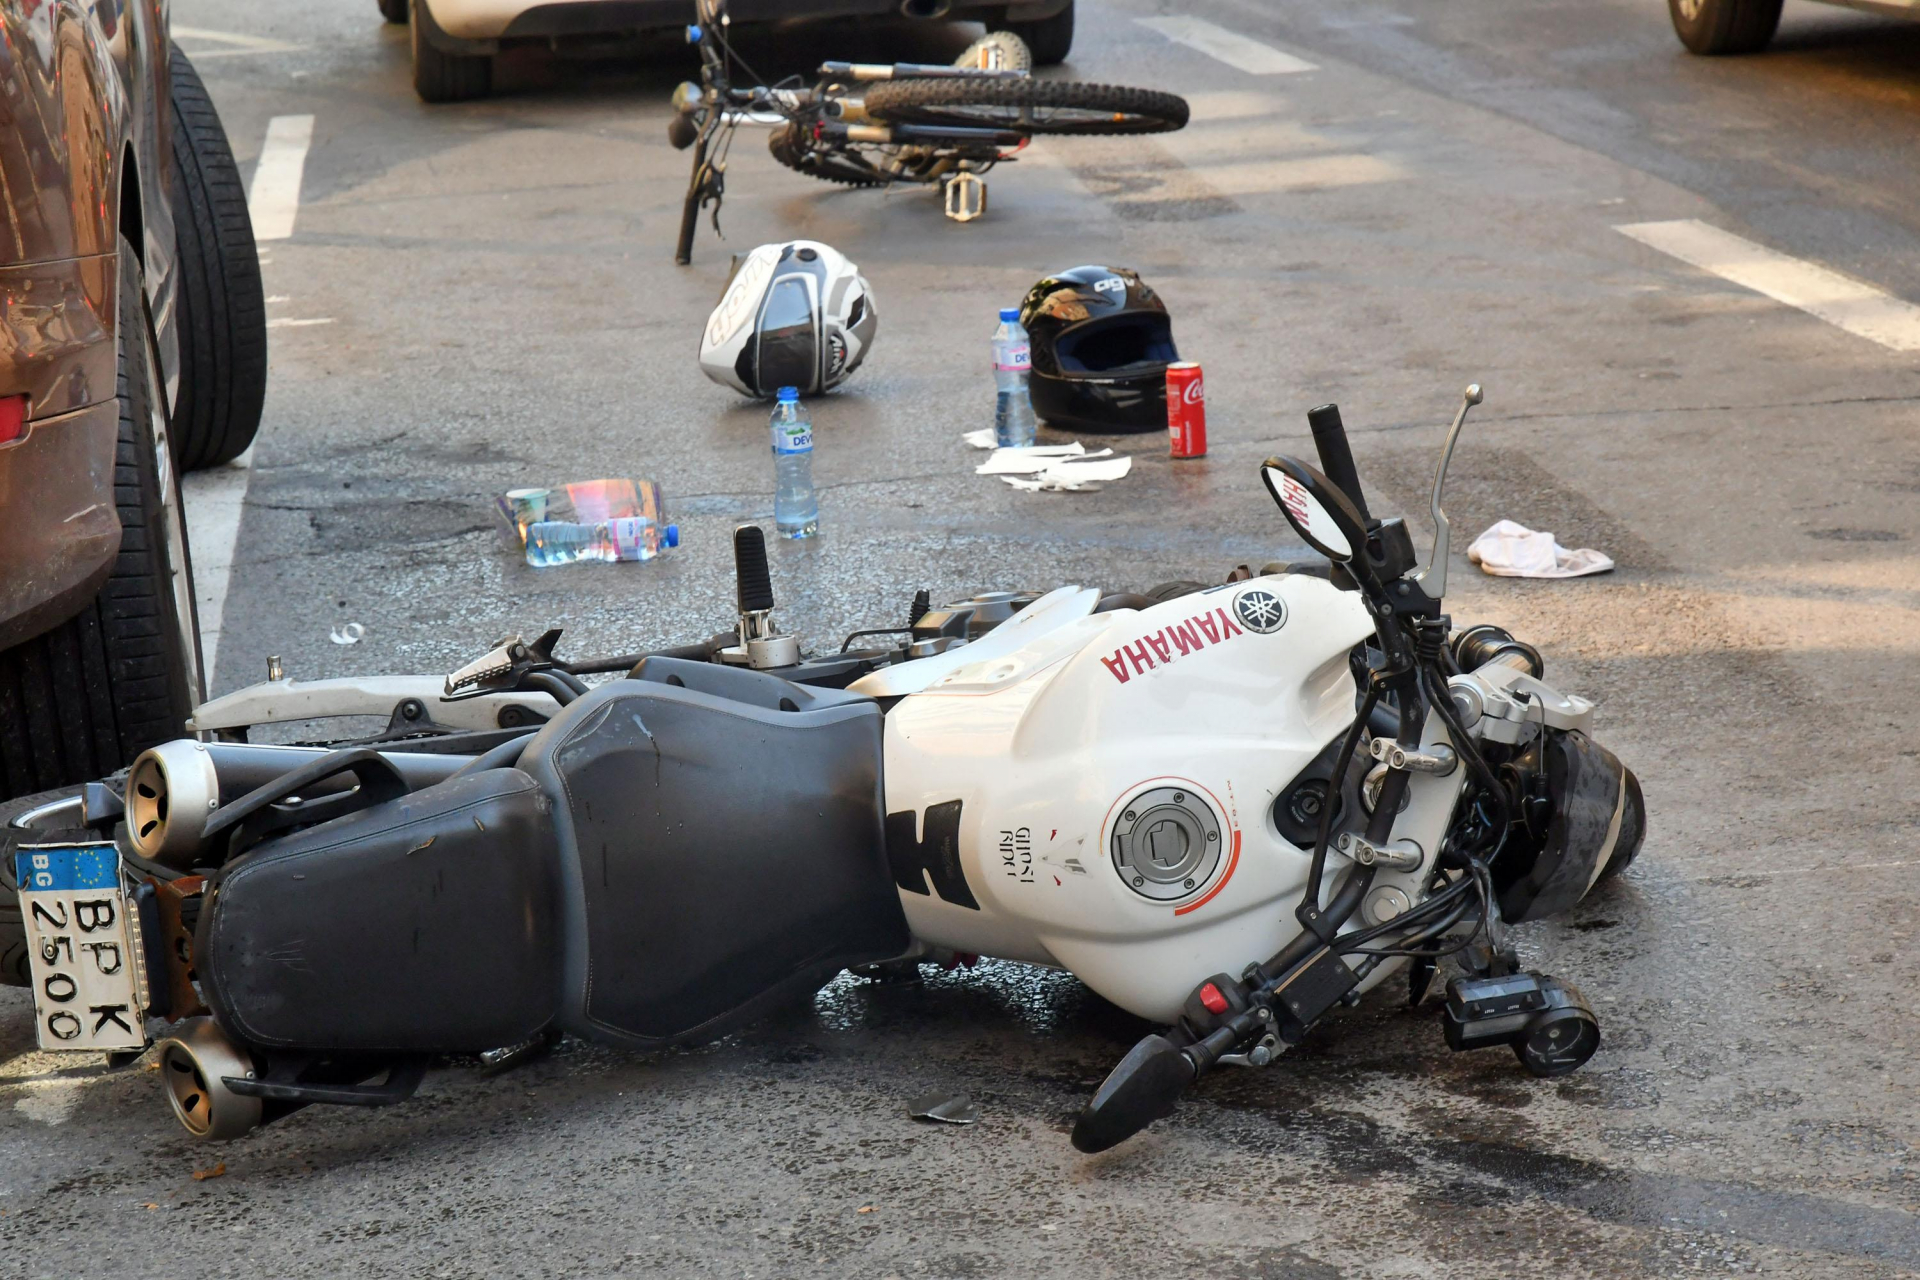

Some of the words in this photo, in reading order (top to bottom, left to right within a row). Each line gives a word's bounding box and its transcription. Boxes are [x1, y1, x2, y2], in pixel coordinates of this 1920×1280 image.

[1094, 278, 1135, 292] agv
[1100, 607, 1243, 684] YAMAHA
[31, 854, 53, 887] BG
[31, 899, 83, 1041] 2500
